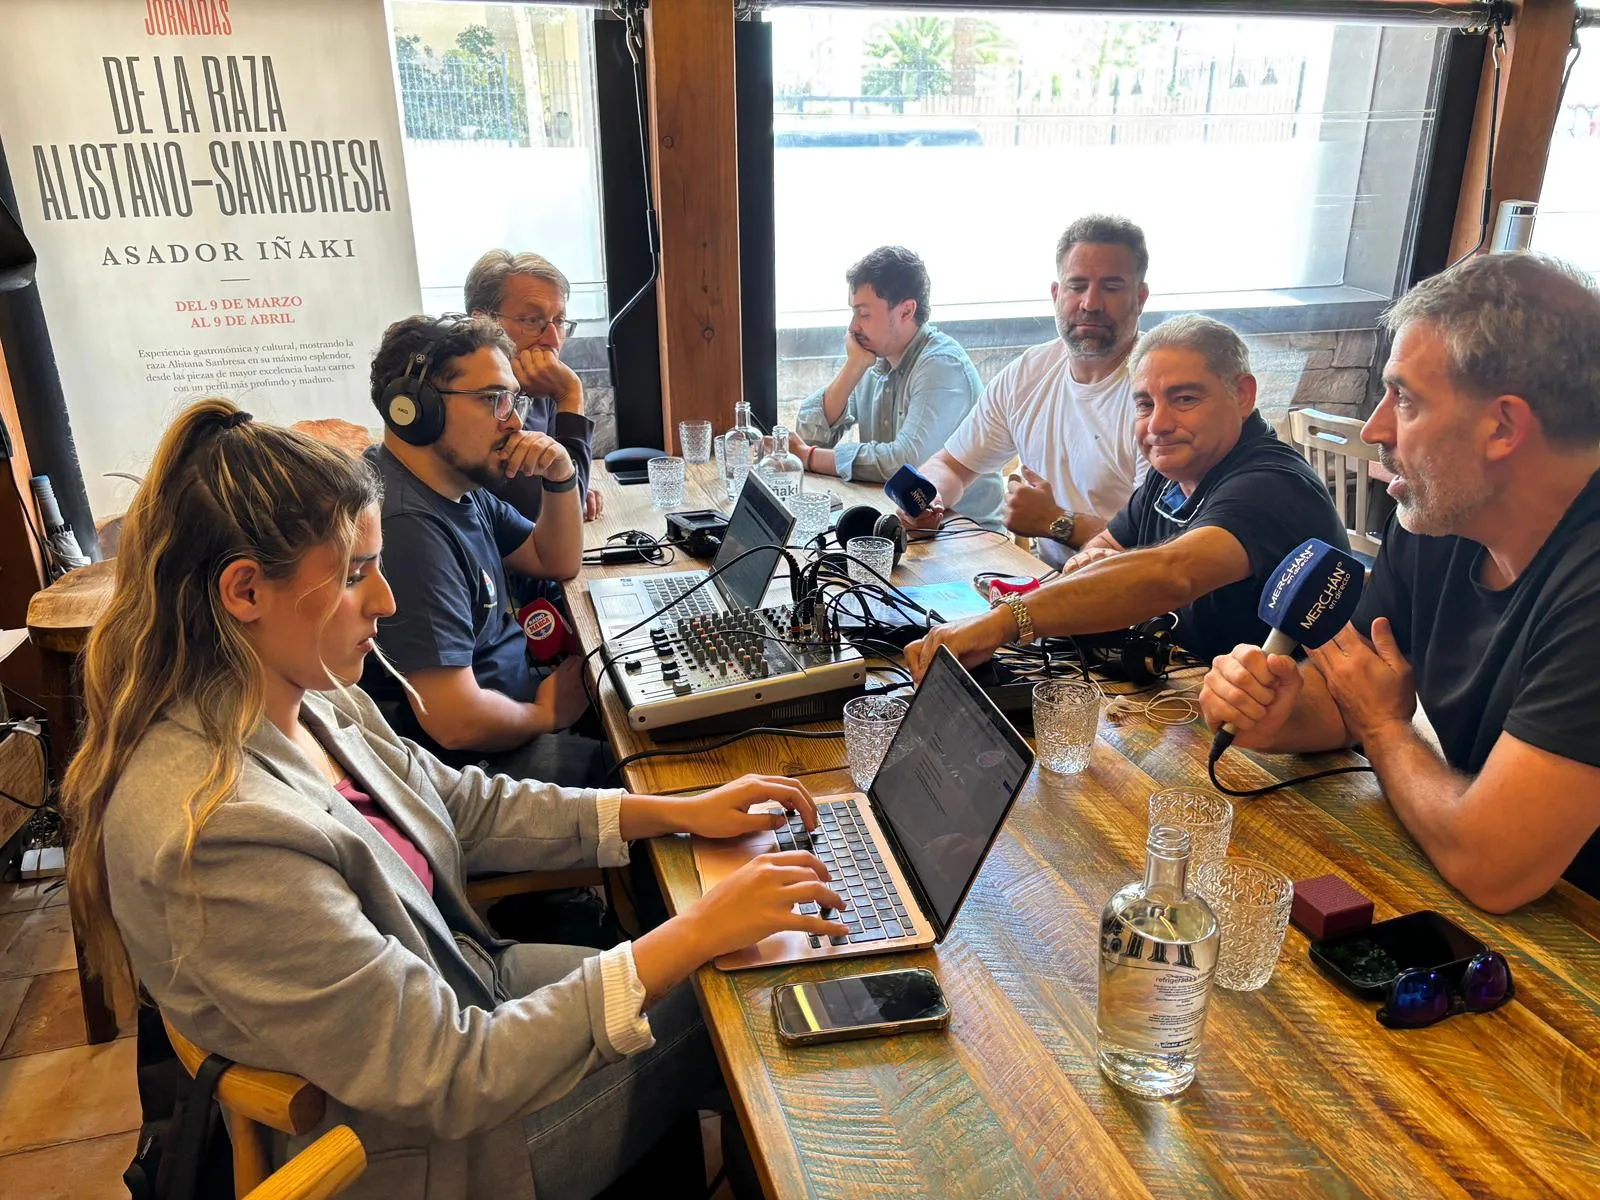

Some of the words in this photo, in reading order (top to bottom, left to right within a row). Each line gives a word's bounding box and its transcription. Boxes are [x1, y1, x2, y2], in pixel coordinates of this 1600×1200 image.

[144, 0, 233, 36] JORNADAS
[102, 56, 154, 135] DE
[153, 55, 201, 134] LA
[201, 55, 287, 133] RAZA
[101, 241, 244, 266] ASADOR
[256, 235, 356, 262] IÑAKI
[175, 300, 207, 312] DEL
[209, 299, 218, 311] 9
[222, 298, 243, 310] DE
[246, 296, 303, 309] MARZO
[190, 317, 211, 329] AL
[213, 316, 221, 327] 9
[225, 315, 247, 327] DE
[250, 313, 295, 325] ABRIL
[138, 347, 191, 359] Experiencia
[193, 345, 252, 357] gastronómica
[254, 346, 260, 354] y
[262, 342, 298, 352] cultural,
[299, 339, 344, 350] mostrando
[346, 339, 354, 347] la
[146, 362, 166, 370] raza
[168, 360, 204, 369] Alistana
[248, 357, 259, 365] en
[272, 353, 308, 363] máximo
[309, 351, 351, 362] esplendor,
[146, 373, 172, 382] desde
[172, 372, 186, 381] las
[187, 371, 214, 382] piezas
[216, 370, 227, 378] de
[229, 369, 257, 379] mayor
[259, 366, 304, 376] excelencia
[304, 364, 327, 373] hasta
[328, 363, 355, 371] carnes
[173, 385, 189, 393] con
[205, 381, 229, 393] perfil
[230, 381, 249, 389] más
[250, 378, 290, 390] profundo
[291, 379, 297, 387] y
[299, 376, 334, 385] maduro.
[1328, 599, 1338, 610] en
[1336, 573, 1351, 600] directo
